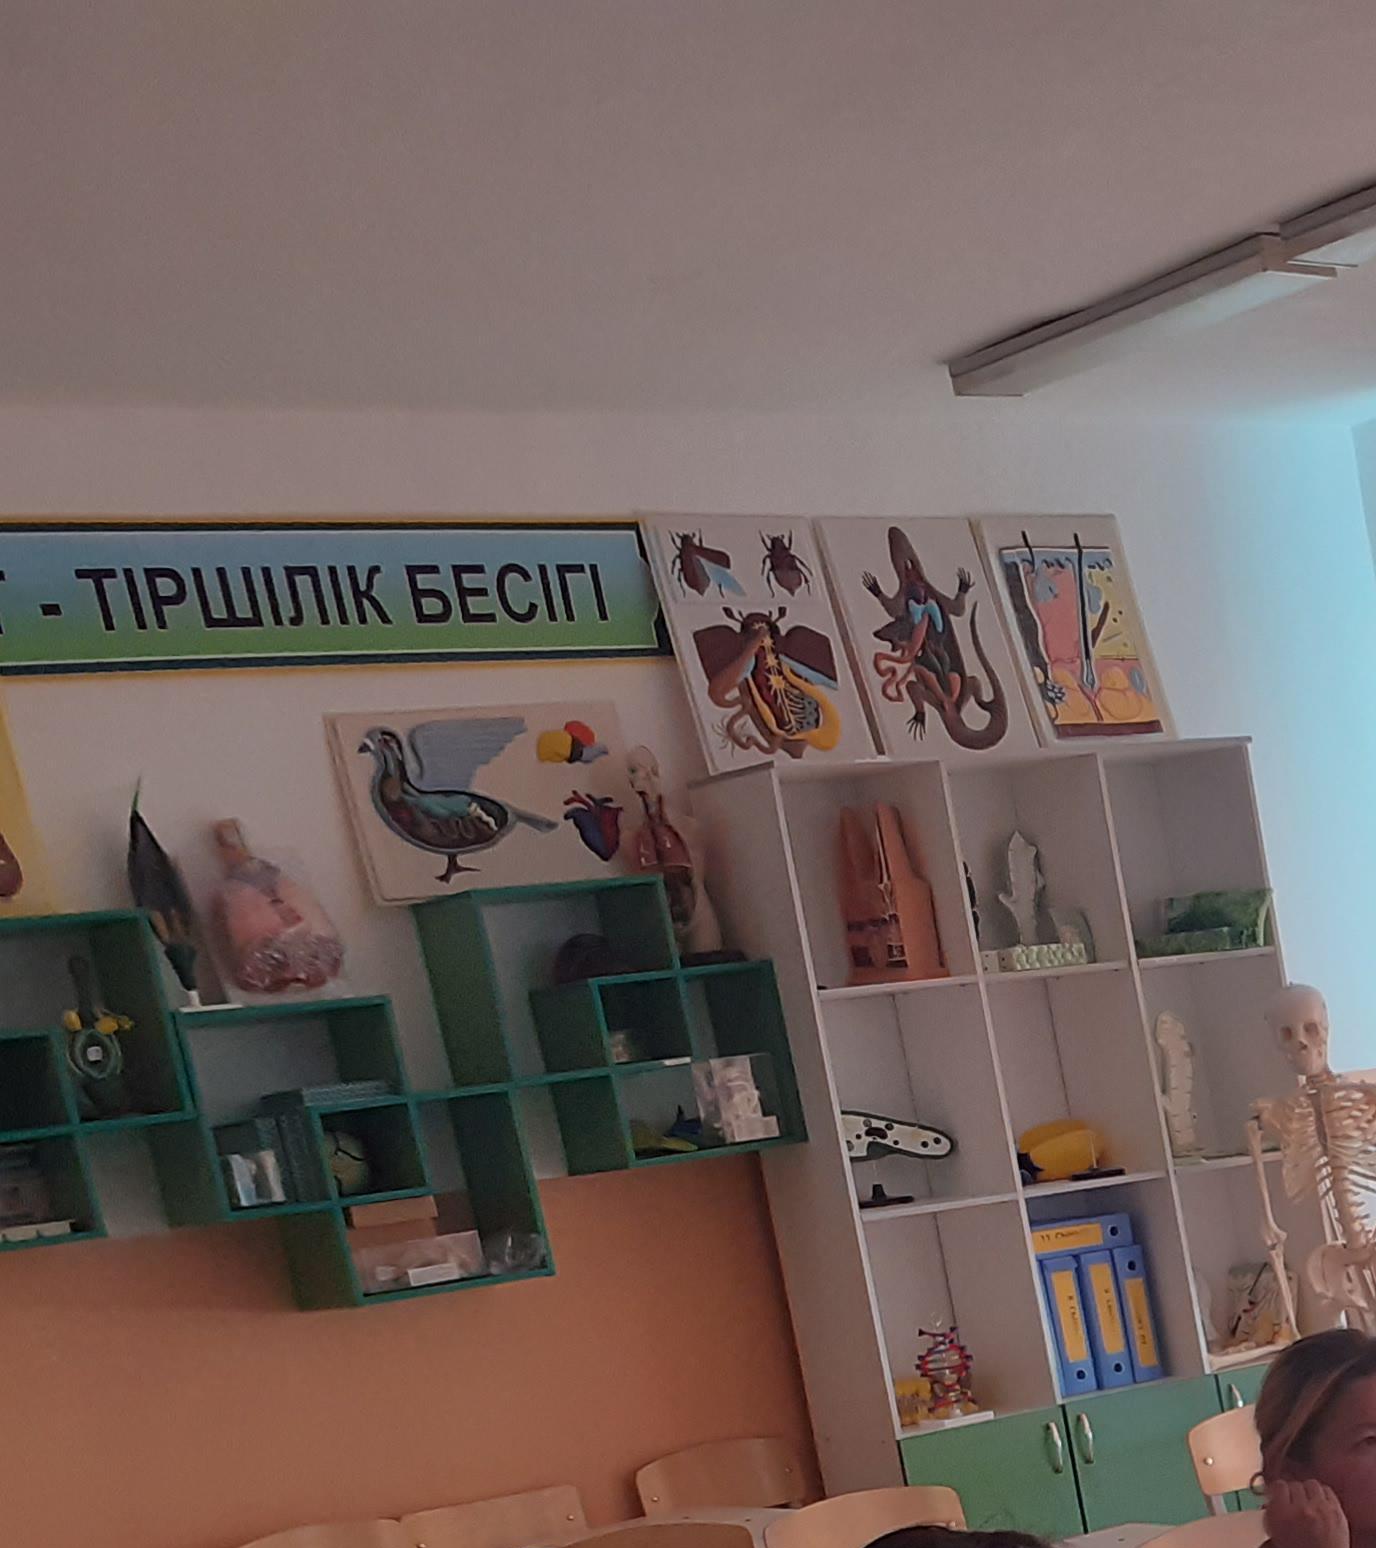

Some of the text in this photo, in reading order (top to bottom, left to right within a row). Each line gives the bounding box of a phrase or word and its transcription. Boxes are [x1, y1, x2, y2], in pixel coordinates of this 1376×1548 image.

[39, 603, 63, 617] -
[74, 564, 393, 632] ТІРШІЛІК
[404, 562, 610, 624] БЕСІГІ
